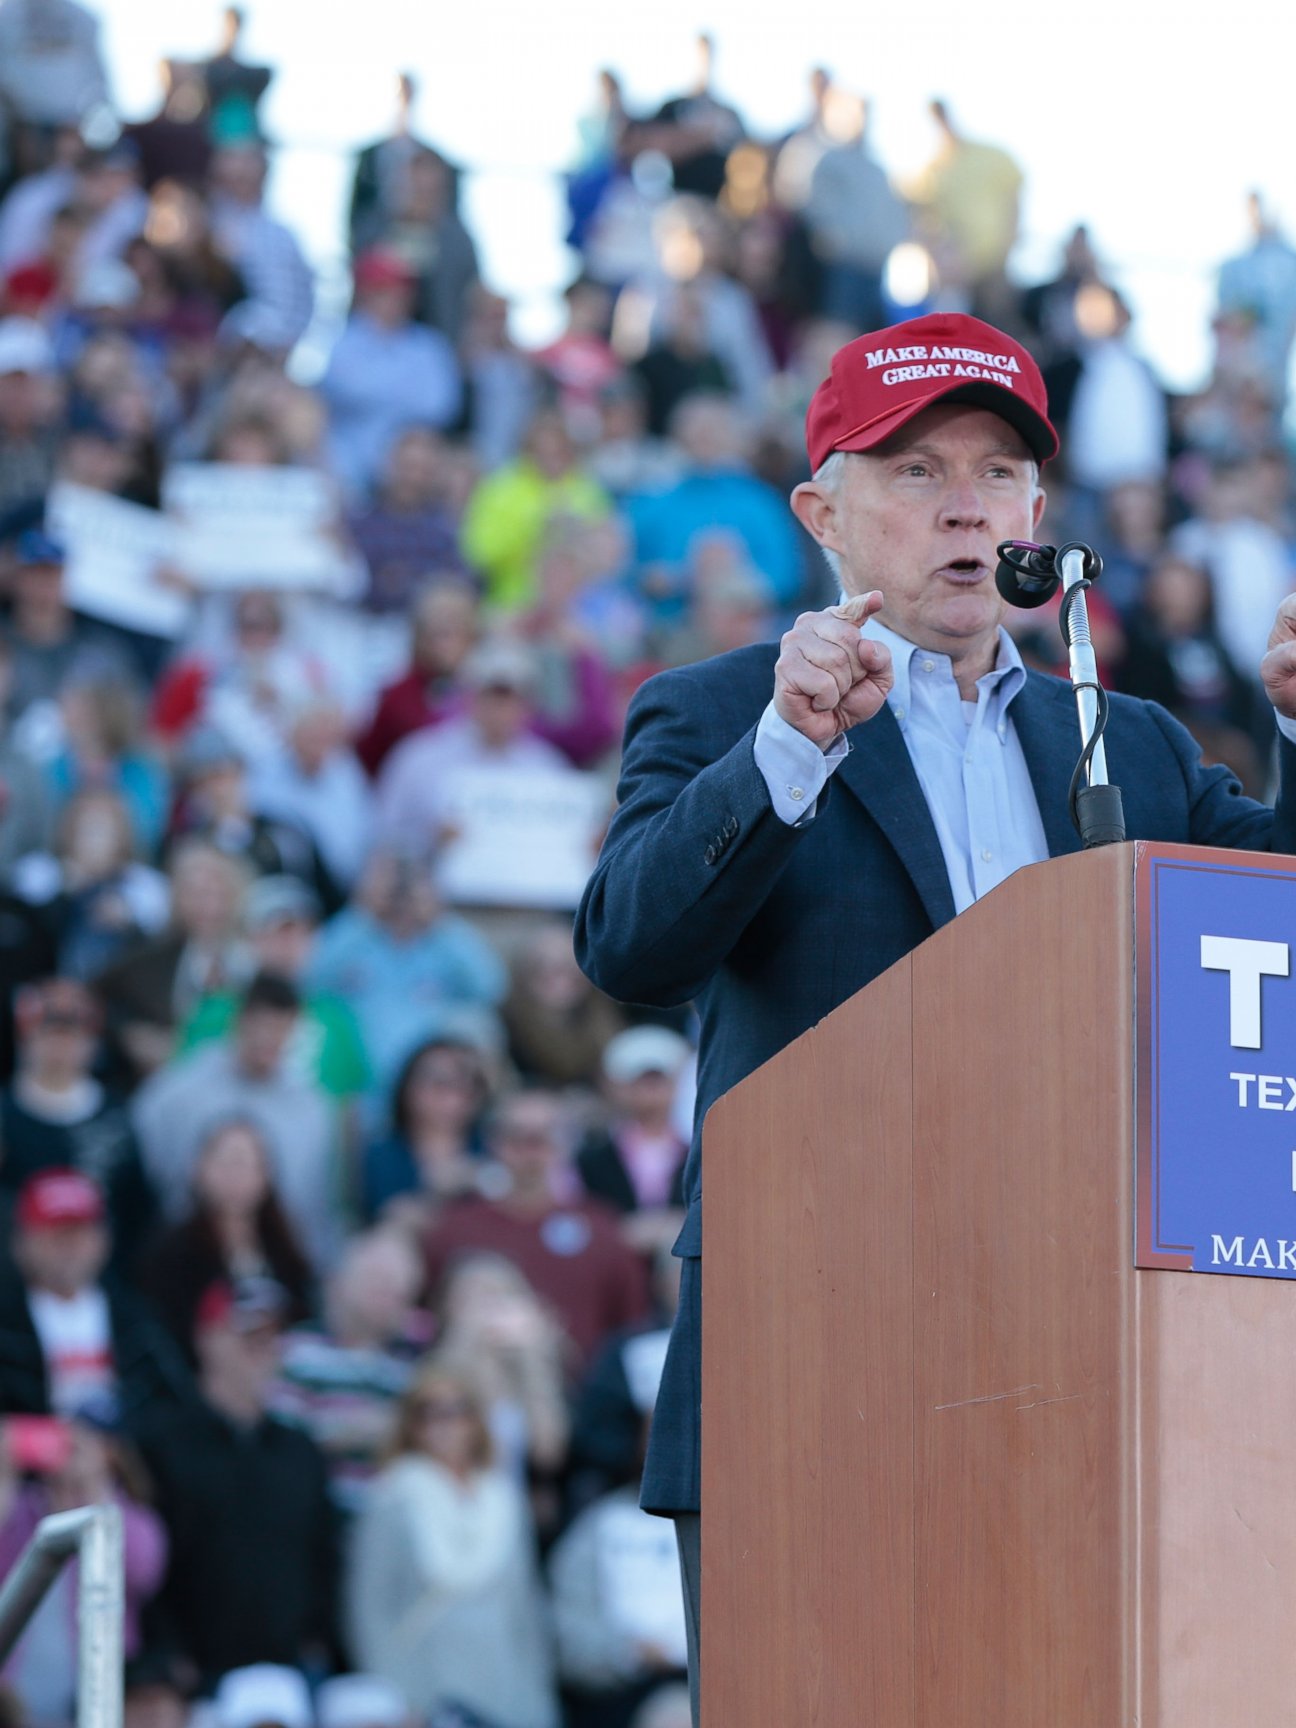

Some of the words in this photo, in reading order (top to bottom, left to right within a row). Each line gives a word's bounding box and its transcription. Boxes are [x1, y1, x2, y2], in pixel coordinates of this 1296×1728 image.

[864, 346, 928, 369] MAKE
[929, 346, 1022, 373] AMERICA
[881, 363, 951, 386] GREAT
[953, 364, 1013, 388] AGAIN
